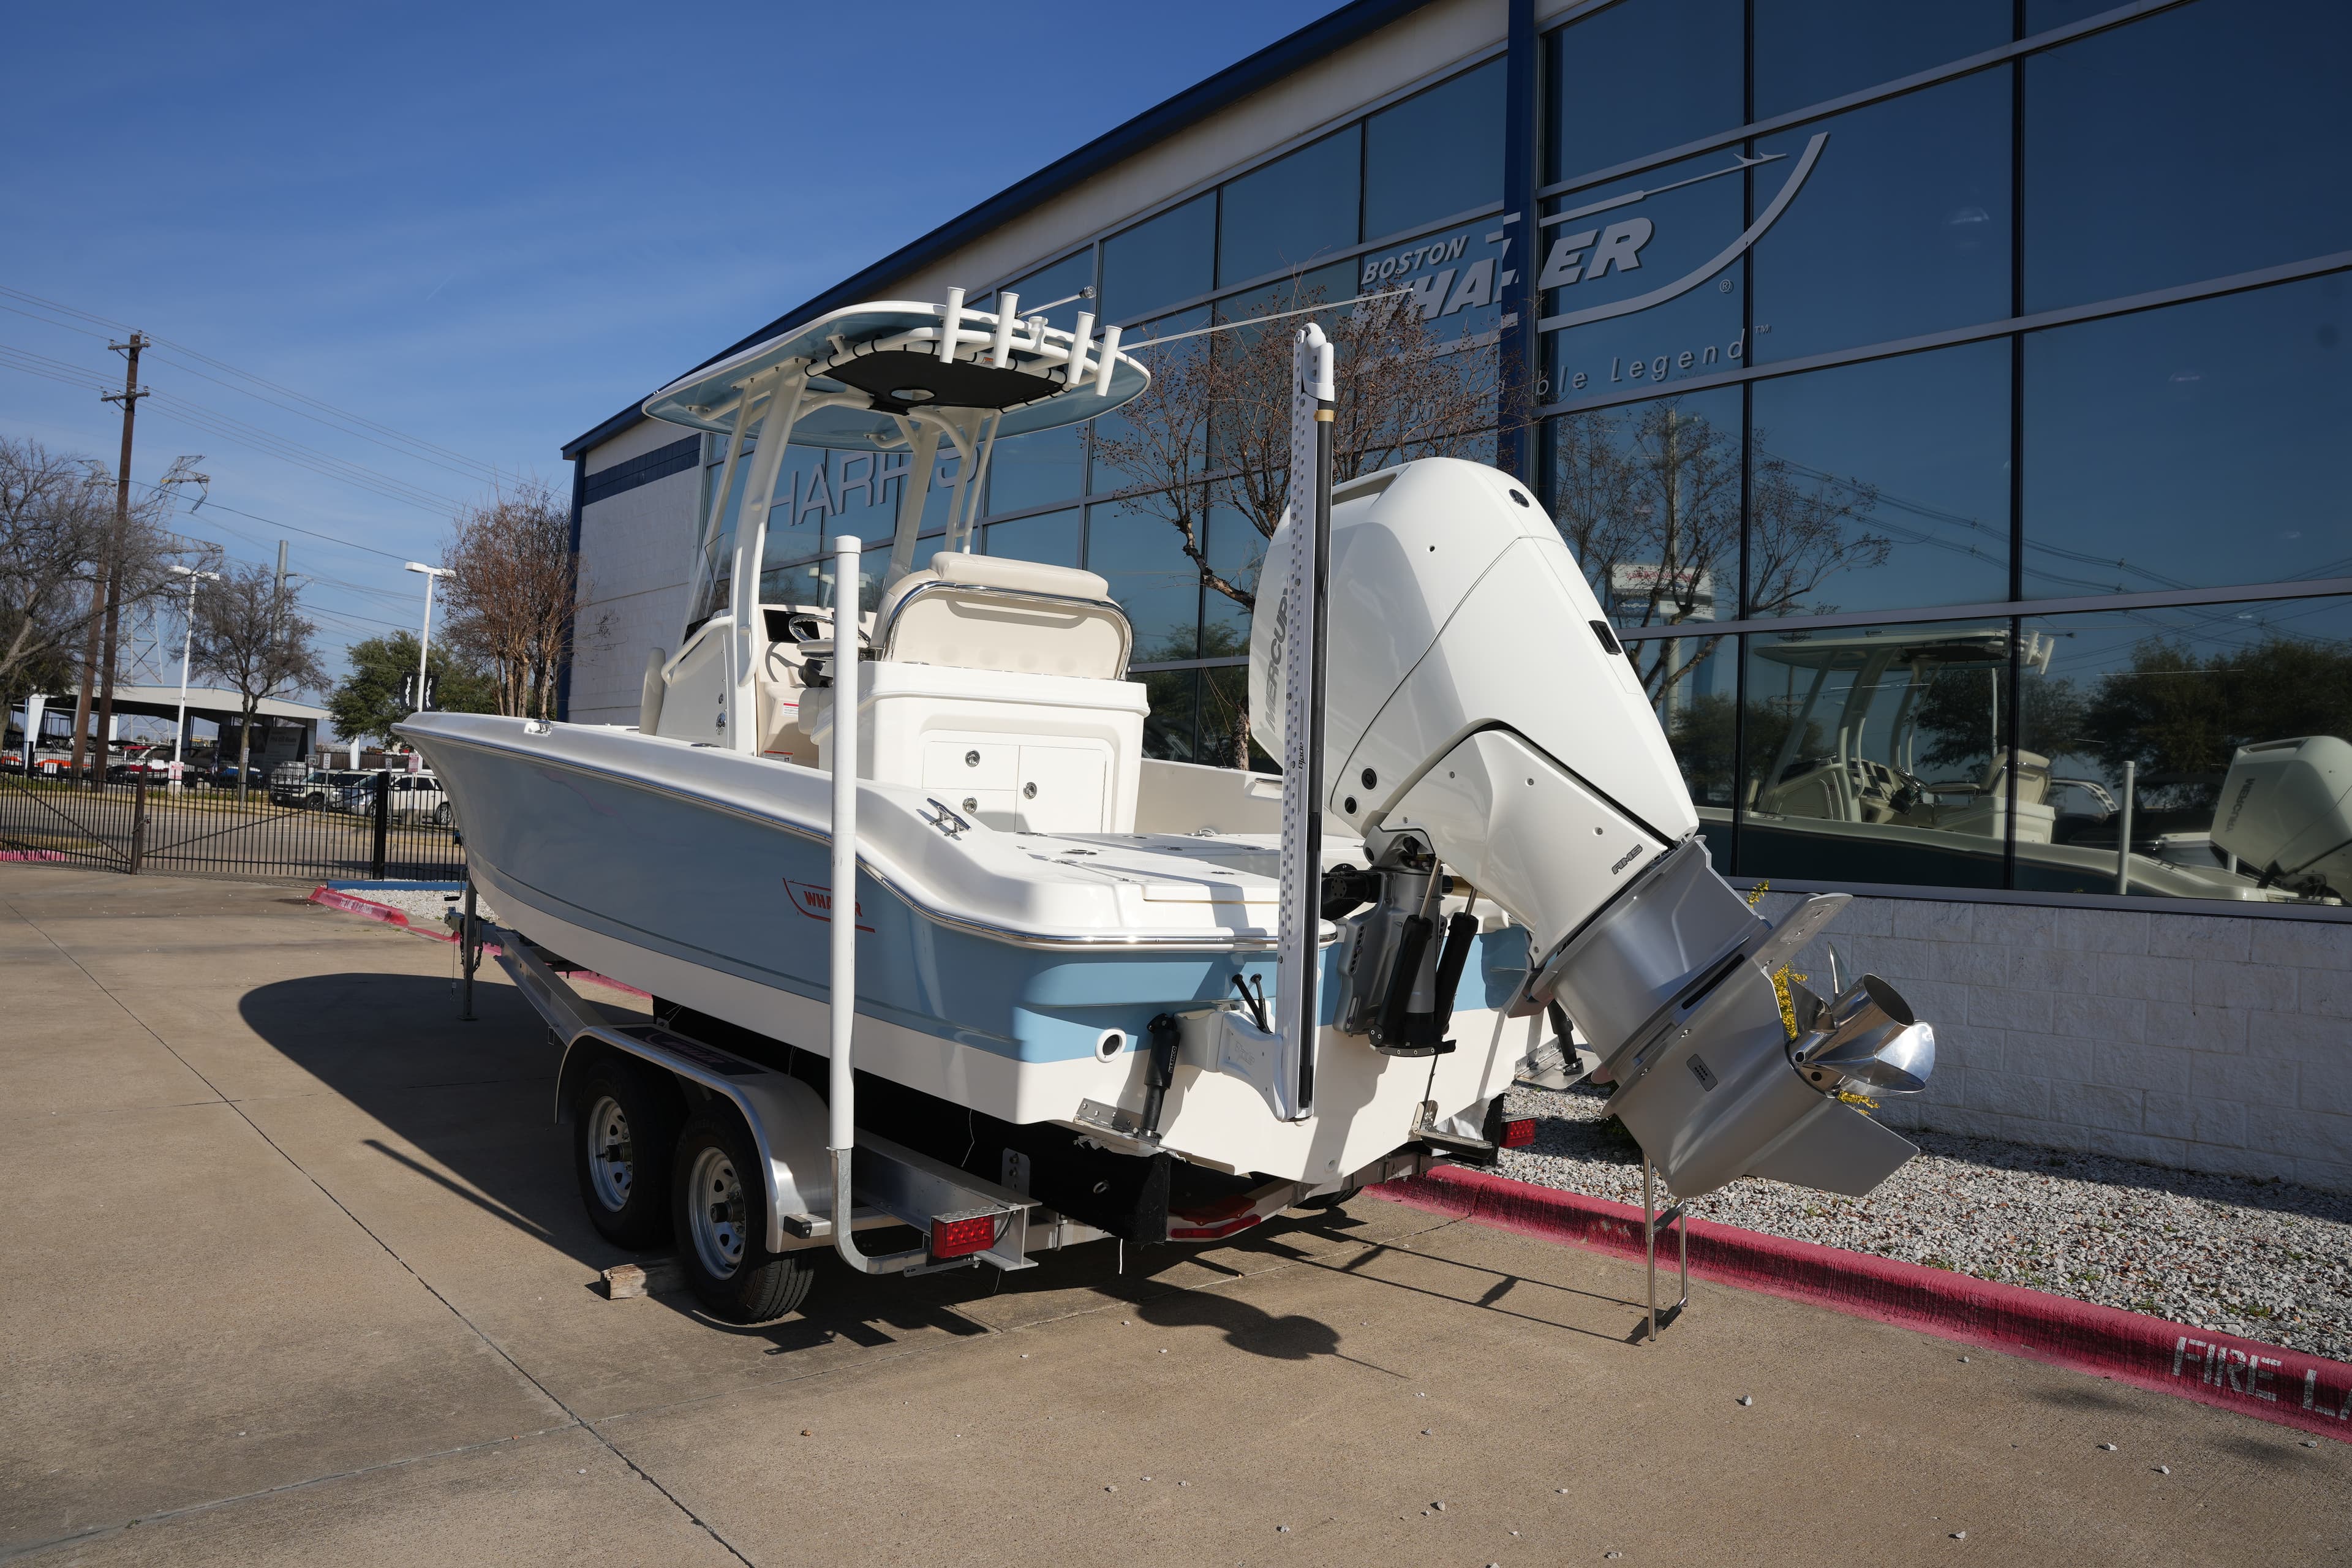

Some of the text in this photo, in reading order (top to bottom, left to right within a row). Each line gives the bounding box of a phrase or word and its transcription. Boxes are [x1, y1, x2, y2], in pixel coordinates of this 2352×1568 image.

[1361, 235, 1469, 285] BOSTON
[1611, 328, 1745, 382] Legend
[1265, 576, 1288, 733] MERCUR
[1611, 844, 1643, 875] AMS
[804, 891, 863, 918] WHAR
[2171, 1336, 2282, 1402] FIRE
